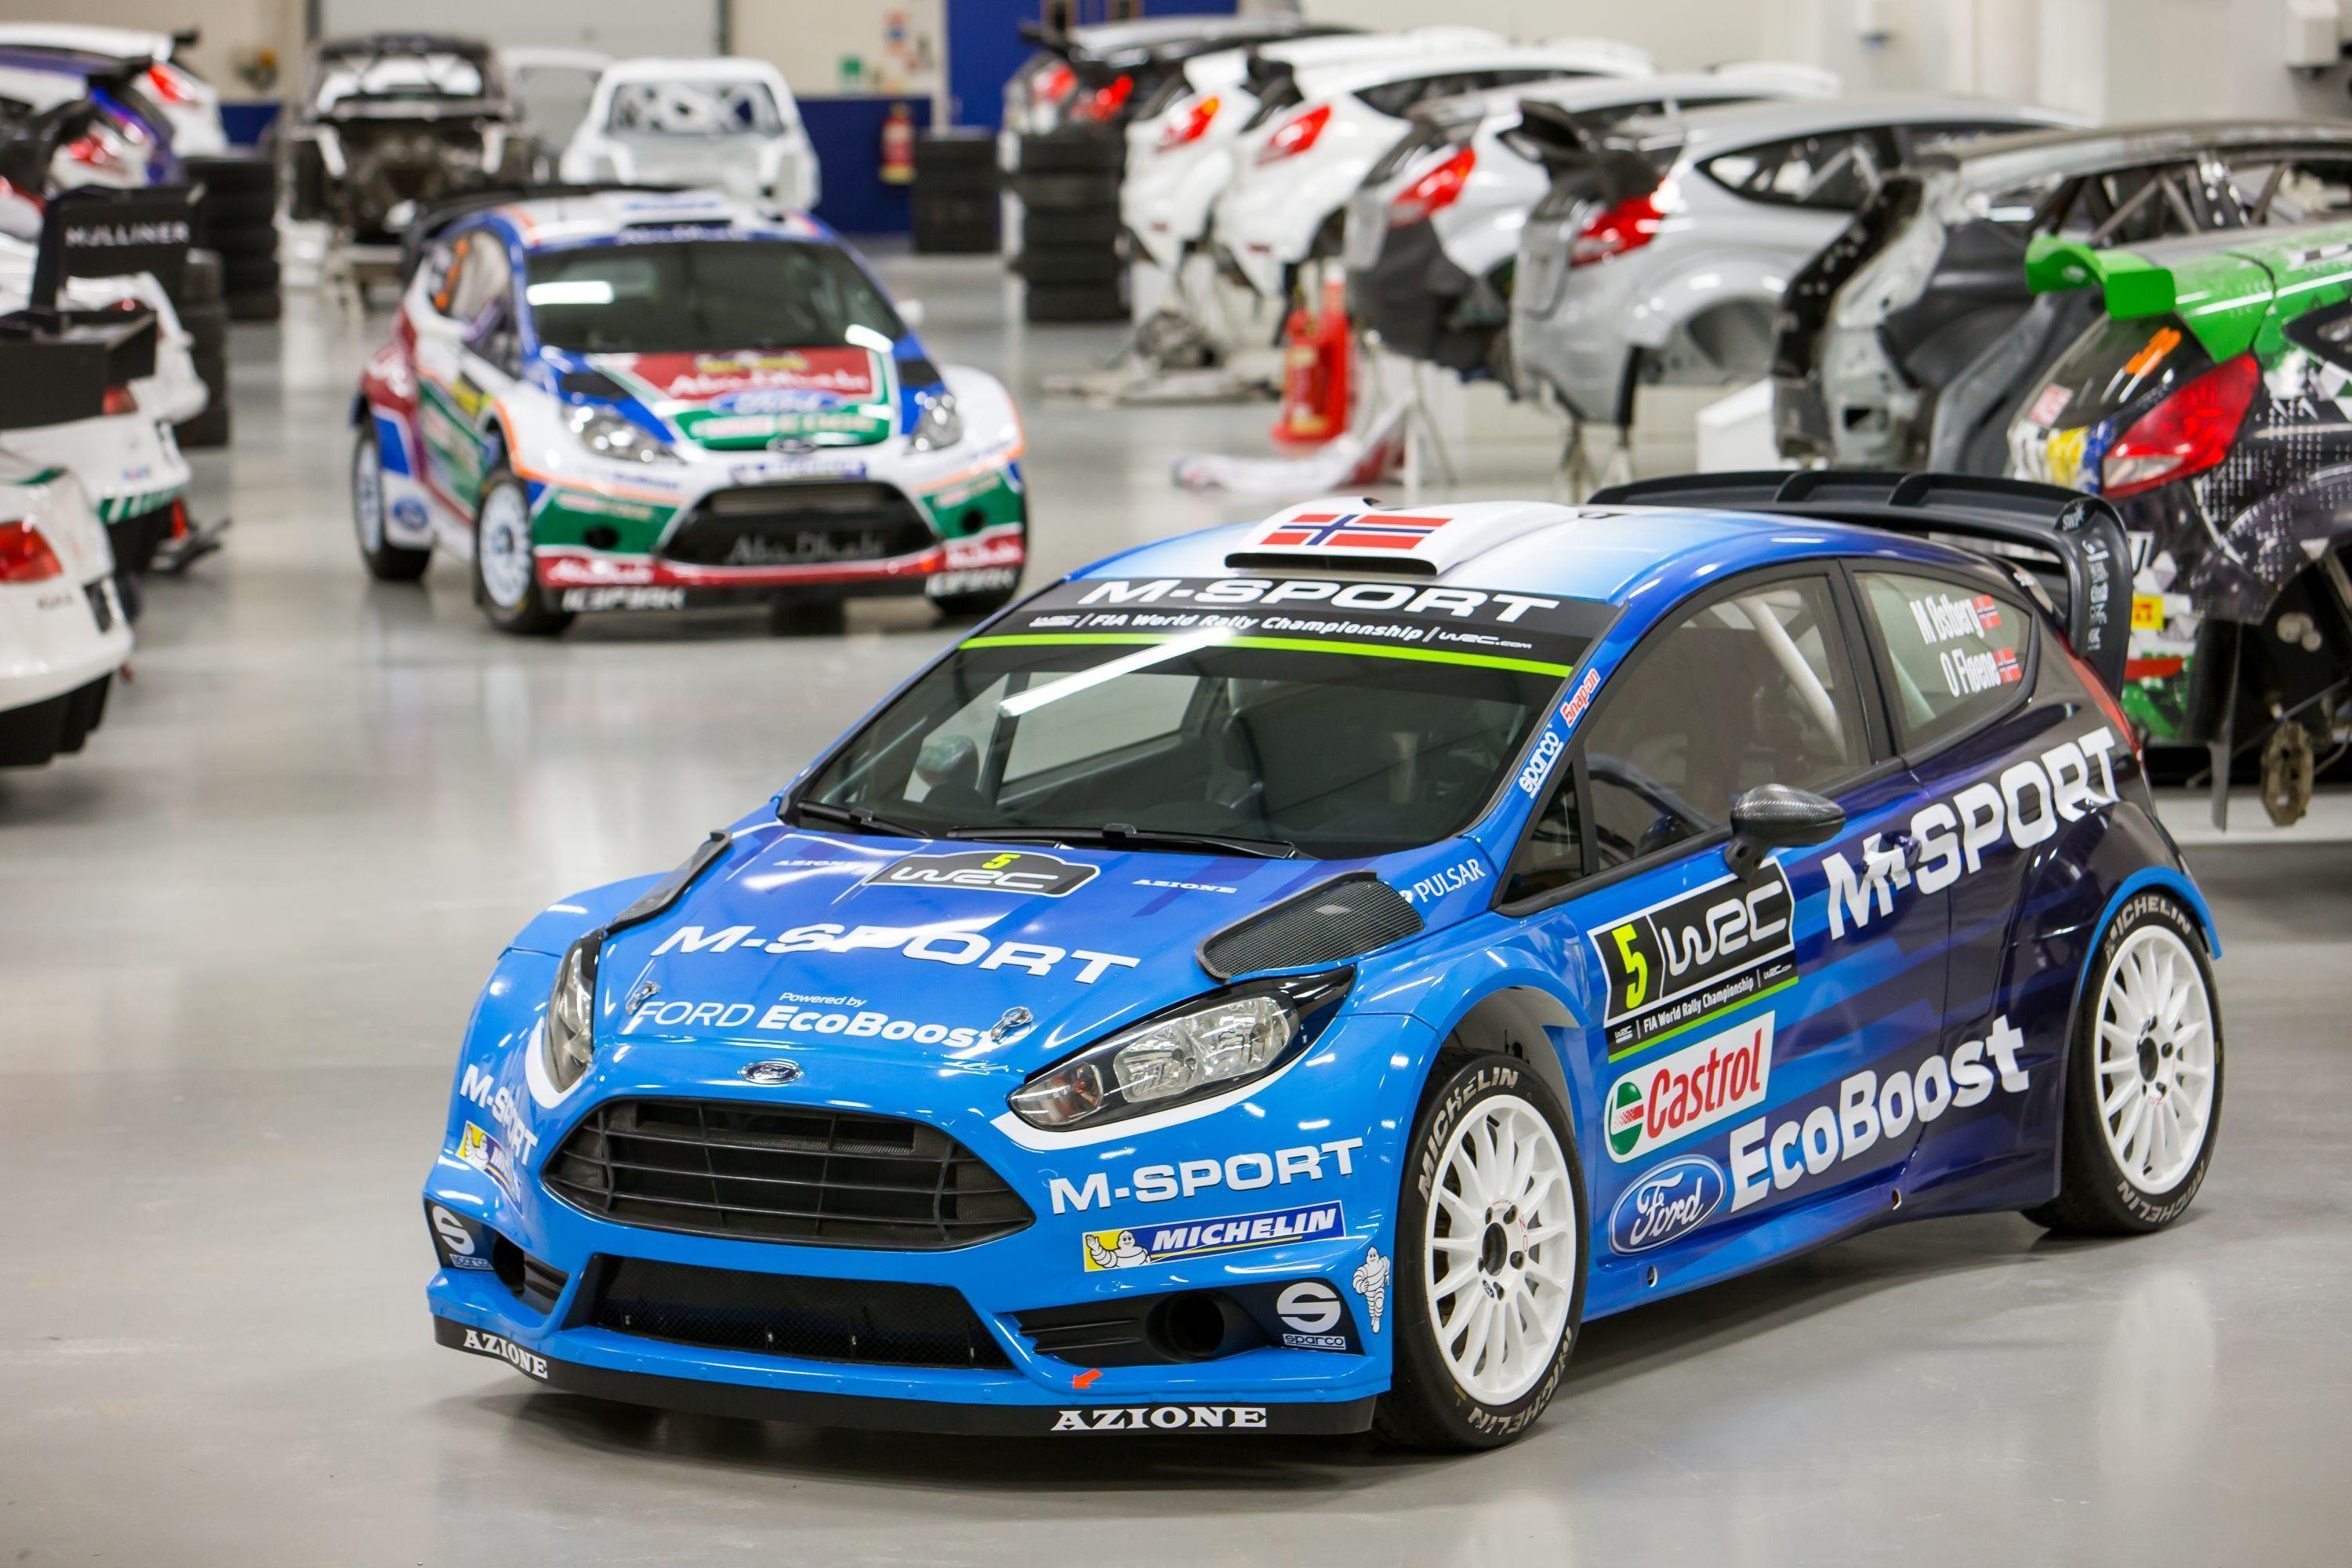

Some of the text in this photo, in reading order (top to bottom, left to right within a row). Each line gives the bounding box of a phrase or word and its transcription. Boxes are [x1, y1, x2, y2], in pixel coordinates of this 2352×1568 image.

[1077, 579, 1560, 623] M-SPORT
[1089, 613, 1129, 627] FIA
[1131, 613, 1199, 627] World
[1199, 614, 1258, 630] Rally
[1261, 616, 1425, 641] Championship
[1909, 598, 1937, 644] M
[1561, 670, 1600, 726] Snap-on
[1940, 652, 1960, 698] O
[1519, 731, 1563, 796] sparco
[1821, 726, 2119, 941] M-SPORT
[890, 866, 1060, 891] WRC
[981, 853, 1022, 870] 5
[1131, 878, 1239, 895] AZIONE
[1412, 858, 1487, 902] PULSAR
[649, 922, 1142, 985] M-SPORT
[1661, 879, 1787, 978] WRC
[2103, 895, 2192, 966] MICHELIN
[1611, 923, 1649, 1010] 5
[631, 1000, 755, 1027] FORD
[779, 991, 868, 1009] Powered by
[1643, 1018, 1659, 1033] FIA
[1658, 1006, 1682, 1028] World
[1682, 998, 1701, 1018] Rally
[1702, 976, 1754, 1007] Championship
[1646, 1027, 1762, 1139] Castrol
[459, 1063, 539, 1167] M-SPORT
[1417, 1066, 1519, 1203] MICHELIN
[1729, 1014, 2031, 1214] EcoBoost
[1049, 1137, 1364, 1215] M-SPORT
[1152, 1207, 1338, 1252] MICHELIN
[1630, 1171, 1706, 1243] Ford
[463, 1328, 549, 1380] AZIONE
[1284, 1334, 1345, 1348] sparco
[1051, 1406, 1267, 1432] AZIONE
